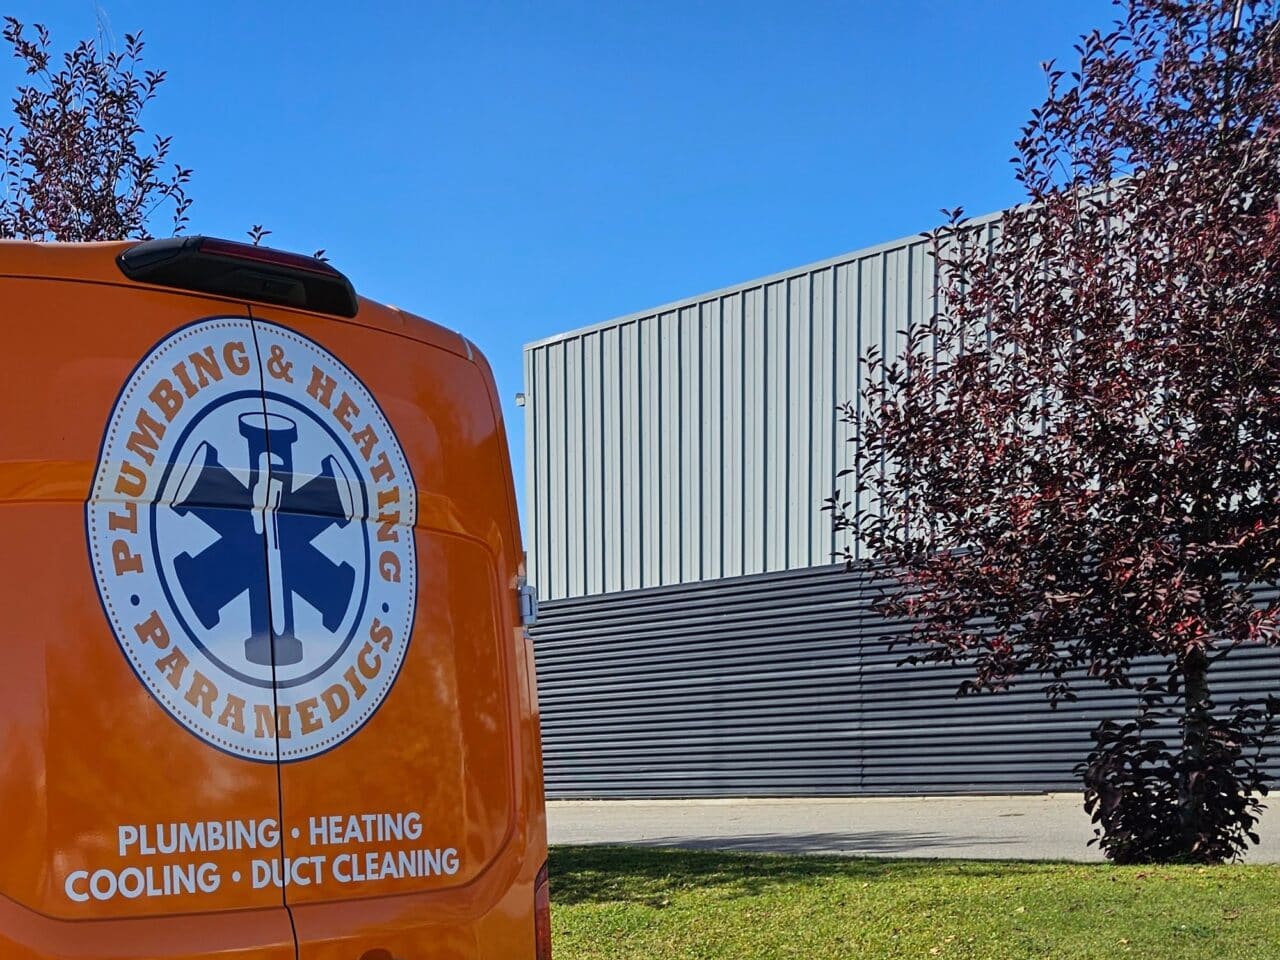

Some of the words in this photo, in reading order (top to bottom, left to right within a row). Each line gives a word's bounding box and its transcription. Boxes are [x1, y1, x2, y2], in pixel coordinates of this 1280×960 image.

[109, 342, 250, 576] PLUMBING
[267, 345, 293, 384] &
[306, 366, 402, 583] HEATING
[134, 611, 394, 738] PARAMEDICS
[65, 863, 221, 902] COOLING
[252, 855, 326, 889] DUCT
[333, 848, 460, 883] CLEANING
[118, 818, 280, 856] PLUMBING
[309, 812, 423, 845] HEATING
